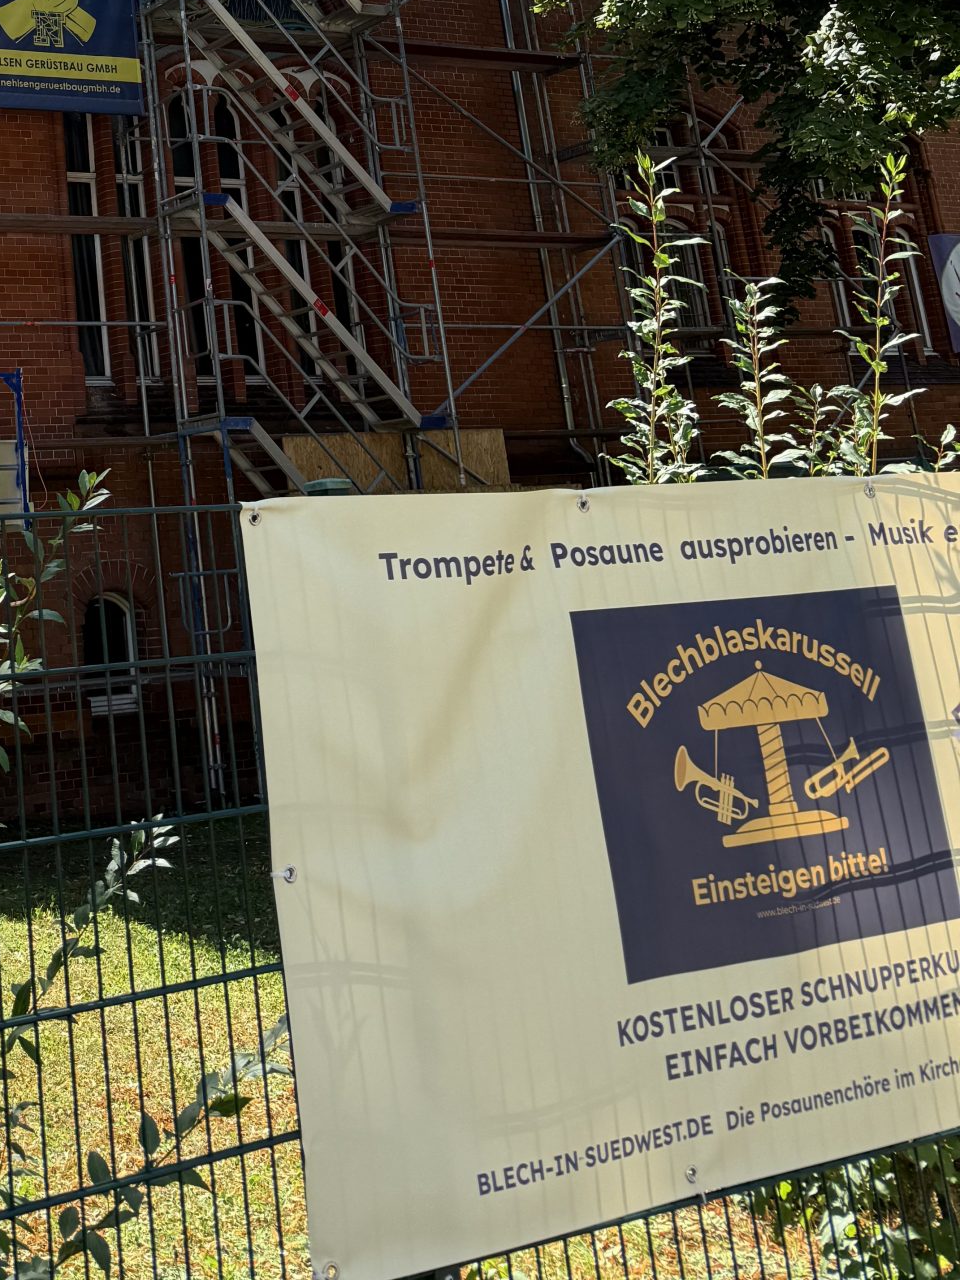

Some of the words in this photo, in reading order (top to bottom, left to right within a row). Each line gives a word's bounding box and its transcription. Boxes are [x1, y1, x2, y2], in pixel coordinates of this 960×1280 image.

[25, 58, 83, 72] GERÜSTBAU
[86, 63, 117, 74] GMBH
[378, 547, 515, 585] Trompete
[550, 540, 664, 569] Posaune
[680, 526, 838, 564] ausprobieren
[869, 521, 933, 547] Musik
[626, 618, 881, 729] Blechblaskarussell
[691, 863, 825, 906] Einsteigen
[829, 847, 889, 882] bitte!
[617, 986, 795, 1048] KOSTENLOSER
[800, 949, 960, 1008] SCHNUPPERKU
[665, 1034, 778, 1081] EINFACH
[476, 1115, 715, 1196] BLECH-IN-SUEDWEST.DE
[725, 1106, 756, 1132] Die
[760, 1075, 892, 1123] Posaunenchöre
[894, 1066, 916, 1089] im
[918, 1055, 960, 1084] Kirch
